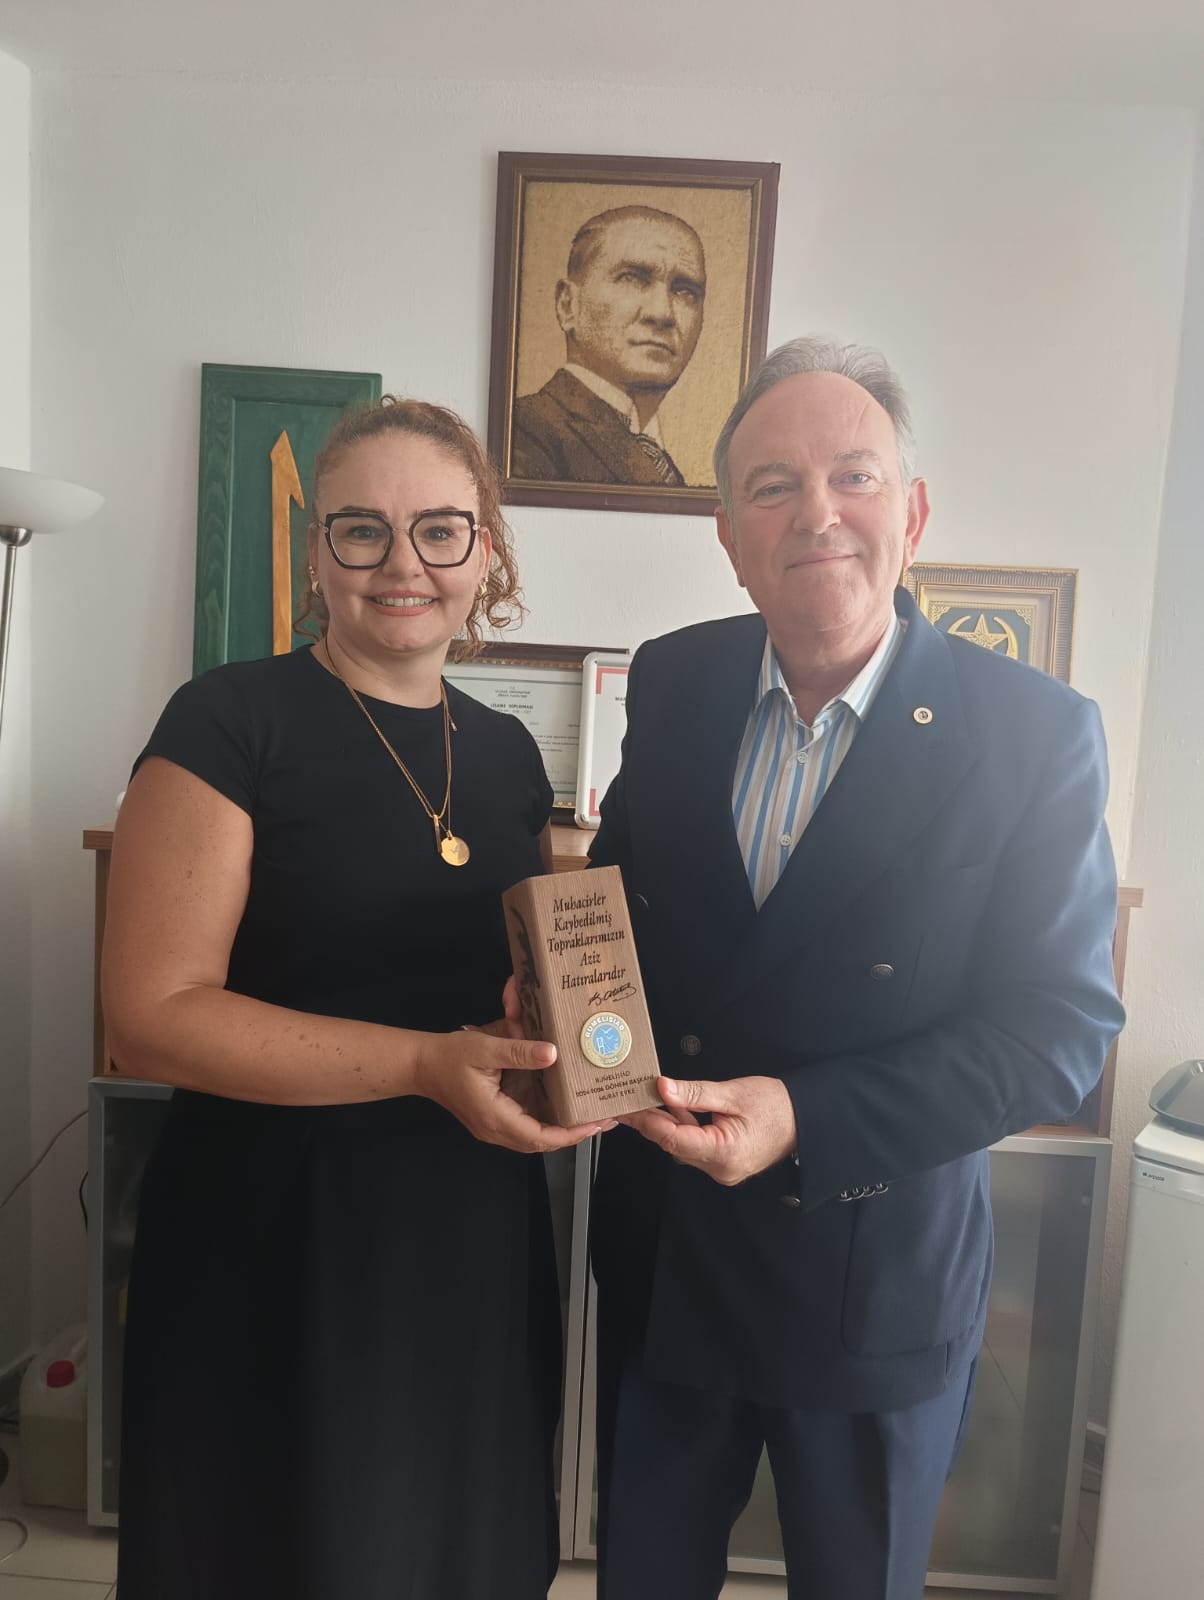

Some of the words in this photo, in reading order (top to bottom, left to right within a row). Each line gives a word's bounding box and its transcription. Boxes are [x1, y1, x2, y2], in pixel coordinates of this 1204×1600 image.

[553, 892, 606, 913] Muhacirler
[554, 910, 612, 934] Kaybedilmiş
[547, 929, 625, 956] Topraklarımızın
[580, 950, 601, 966] Aziz
[561, 965, 626, 990] Hatıralarıdır
